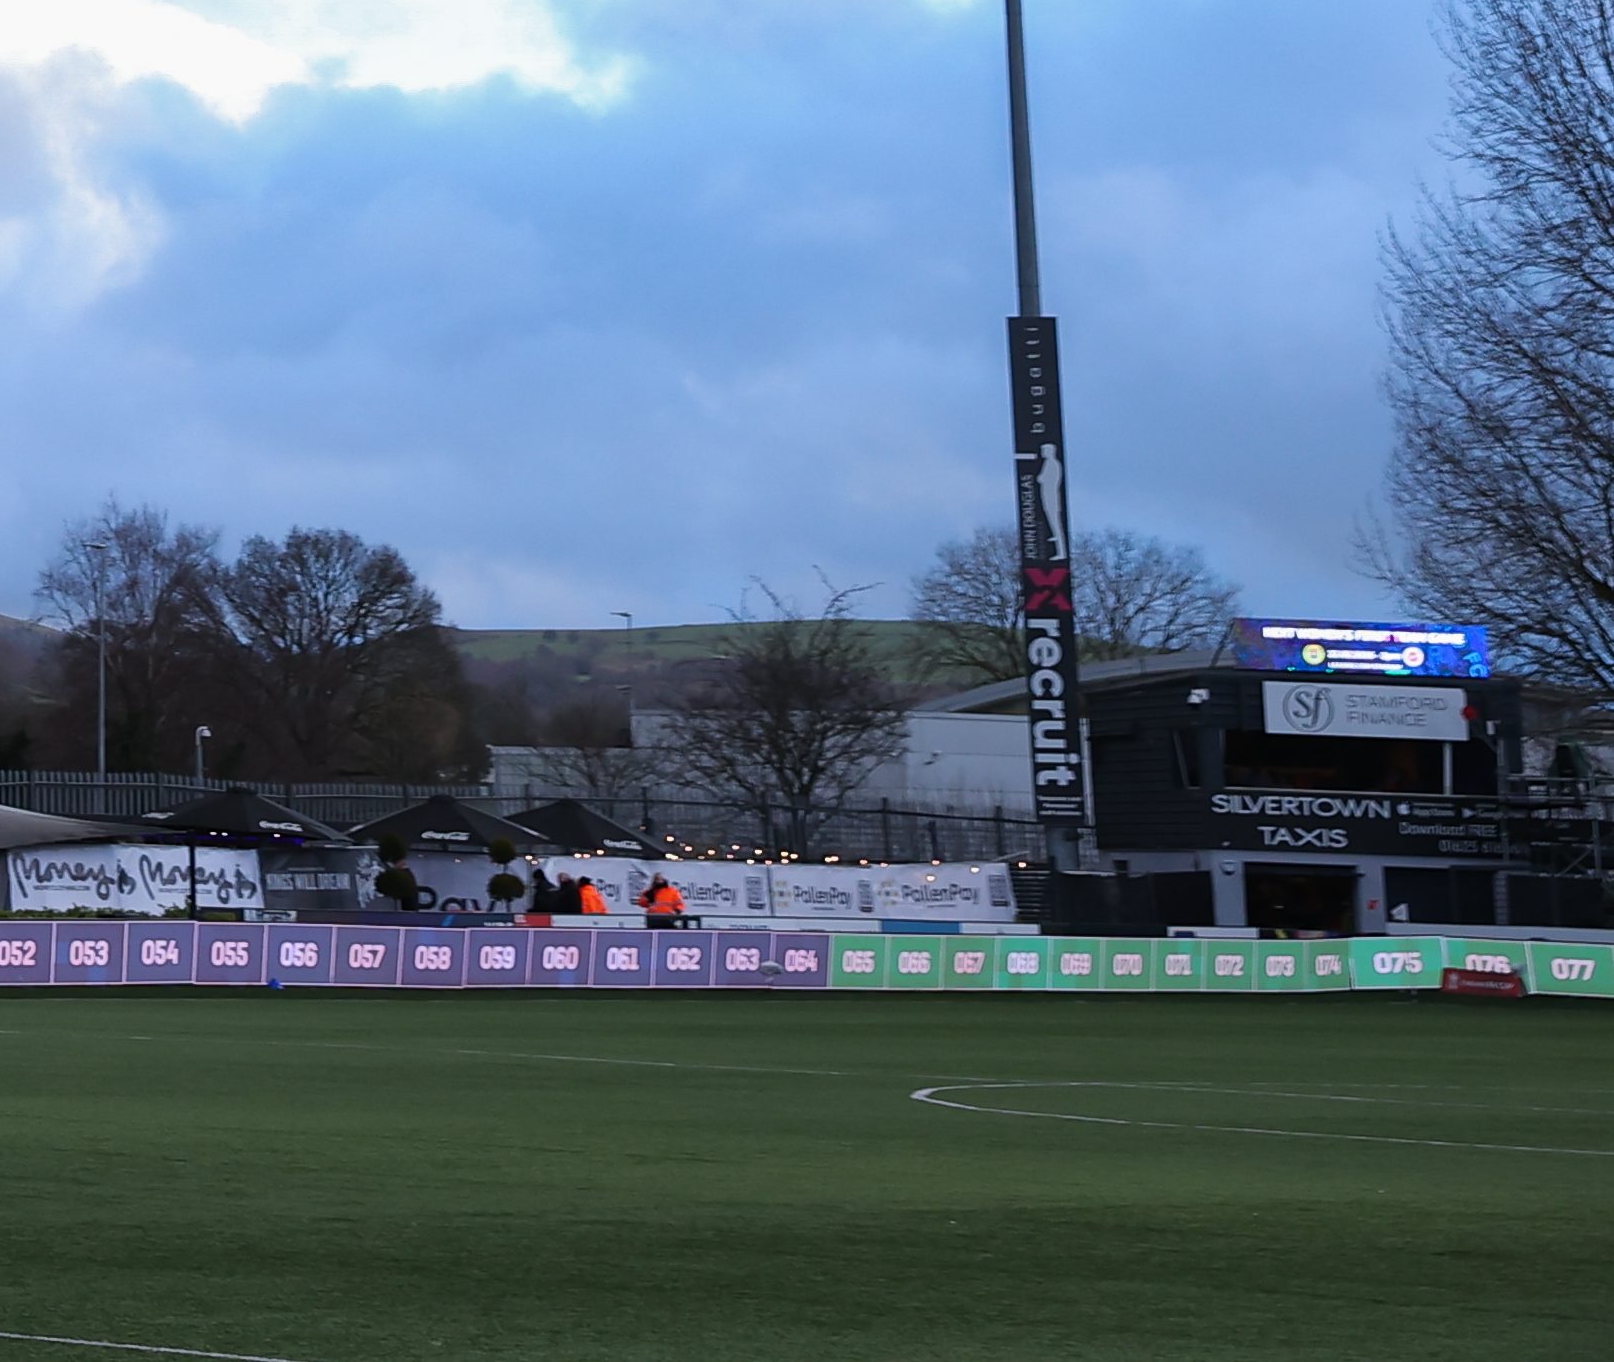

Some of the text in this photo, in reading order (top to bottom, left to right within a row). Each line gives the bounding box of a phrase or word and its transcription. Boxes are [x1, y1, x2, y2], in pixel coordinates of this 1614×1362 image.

[1021, 474, 1037, 559] JOHN DOUGLAS
[1027, 618, 1080, 786] recruit
[1346, 693, 1448, 711] STAMFORD
[1346, 710, 1428, 727] FINANCE
[1211, 794, 1392, 820] SILVERTOWN
[1257, 826, 1349, 848] TAXIS
[69, 940, 109, 966] 053
[141, 940, 179, 965] 054
[211, 941, 249, 966] 055
[280, 942, 318, 967] 056
[348, 943, 386, 968] 057
[414, 945, 452, 970] 058
[479, 945, 516, 970] 059
[542, 946, 580, 970] 060
[606, 947, 640, 971] 061
[666, 947, 702, 971] 062
[725, 947, 760, 971] 063
[784, 949, 818, 972] 064
[1373, 951, 1423, 974] 075
[1551, 958, 1595, 980] 077
